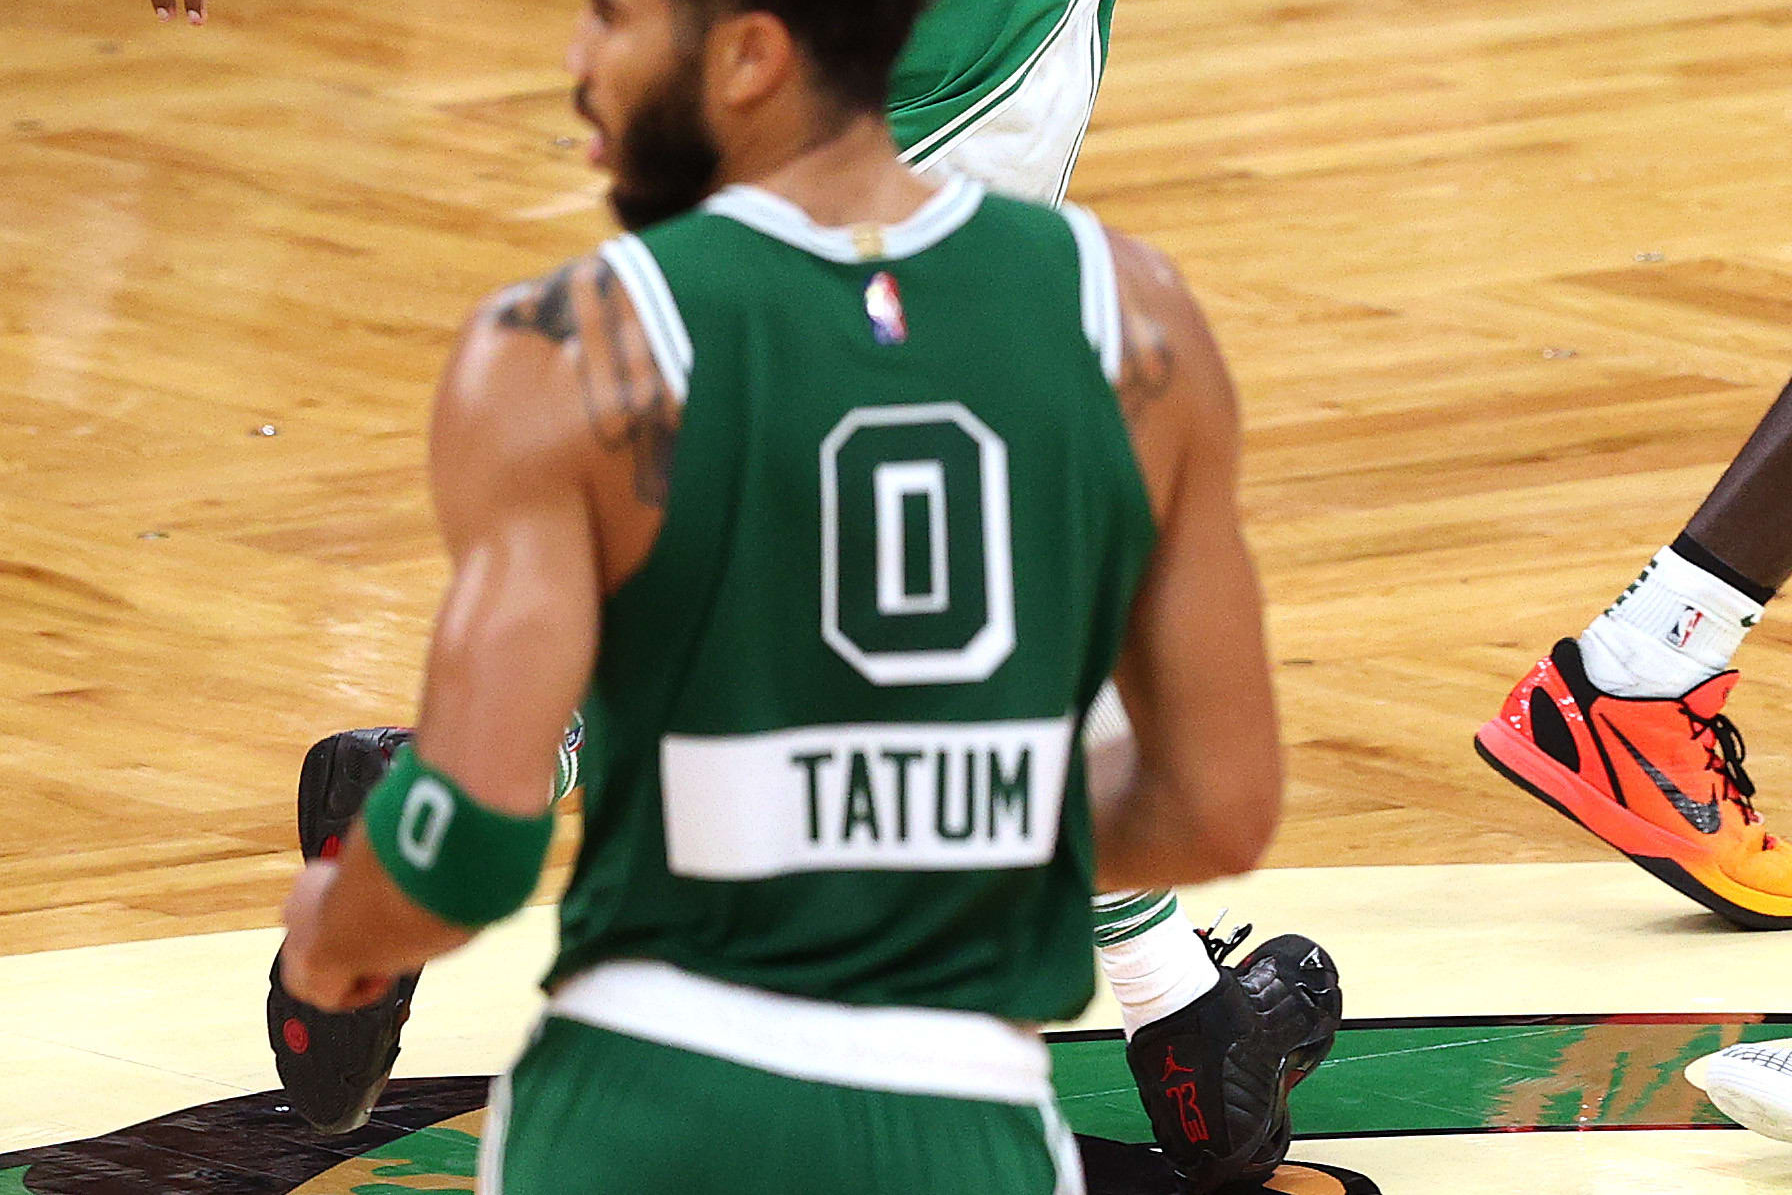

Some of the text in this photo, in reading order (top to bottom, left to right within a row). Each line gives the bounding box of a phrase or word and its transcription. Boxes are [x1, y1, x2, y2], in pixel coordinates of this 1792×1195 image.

[820, 402, 1017, 686] 0
[398, 777, 455, 870] 0
[793, 744, 1031, 845] TATUM
